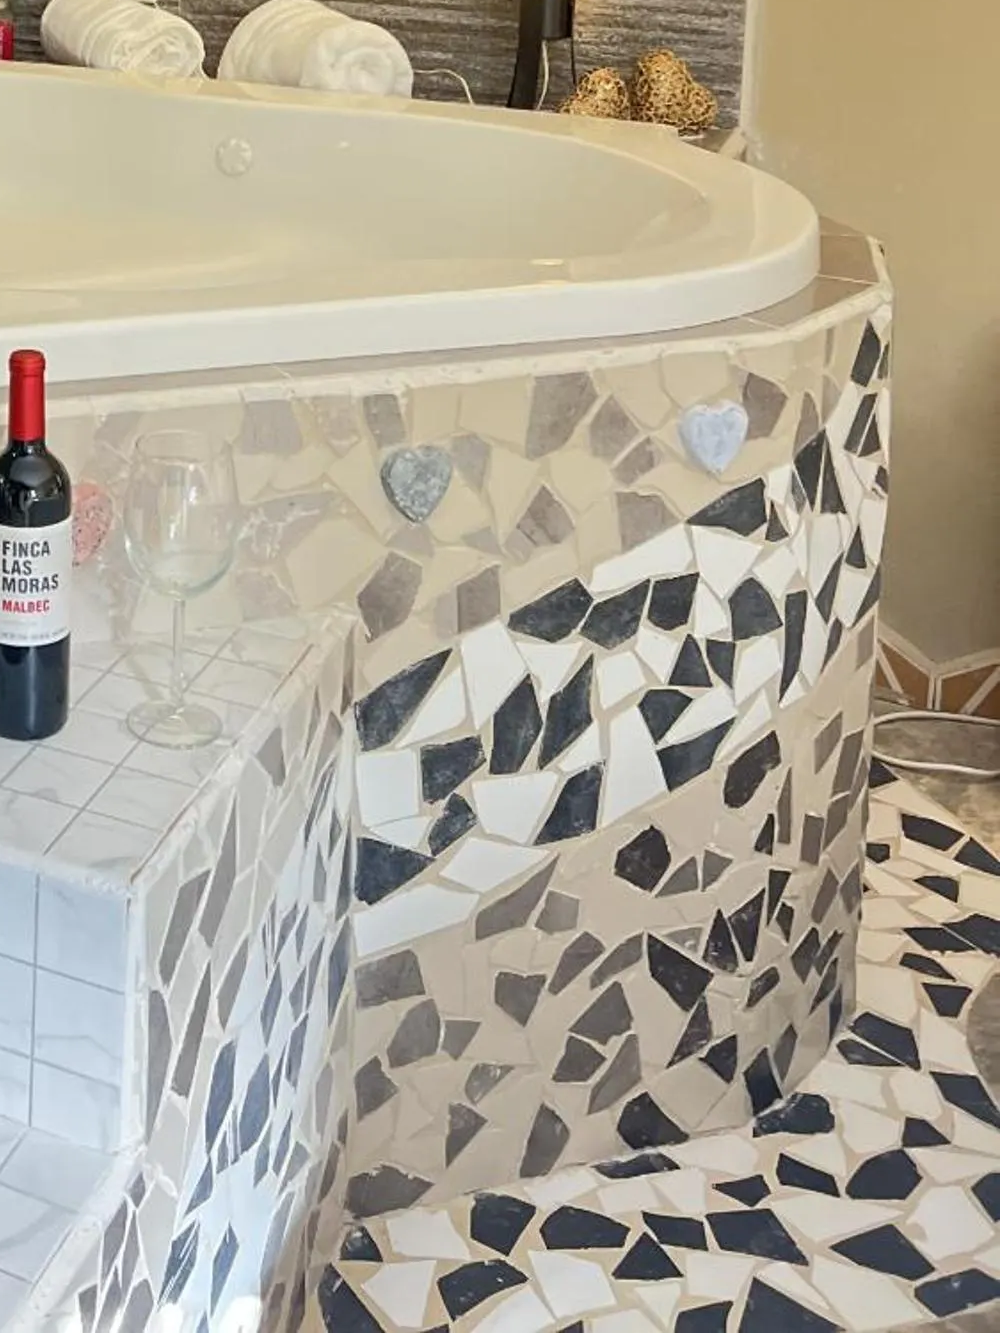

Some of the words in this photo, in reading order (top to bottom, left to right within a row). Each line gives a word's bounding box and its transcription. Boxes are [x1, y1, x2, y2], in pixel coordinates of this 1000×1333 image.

[2, 540, 50, 557] FINCA
[2, 558, 32, 576] LAS
[2, 574, 59, 594] MORAS
[2, 599, 50, 613] MALBEC
